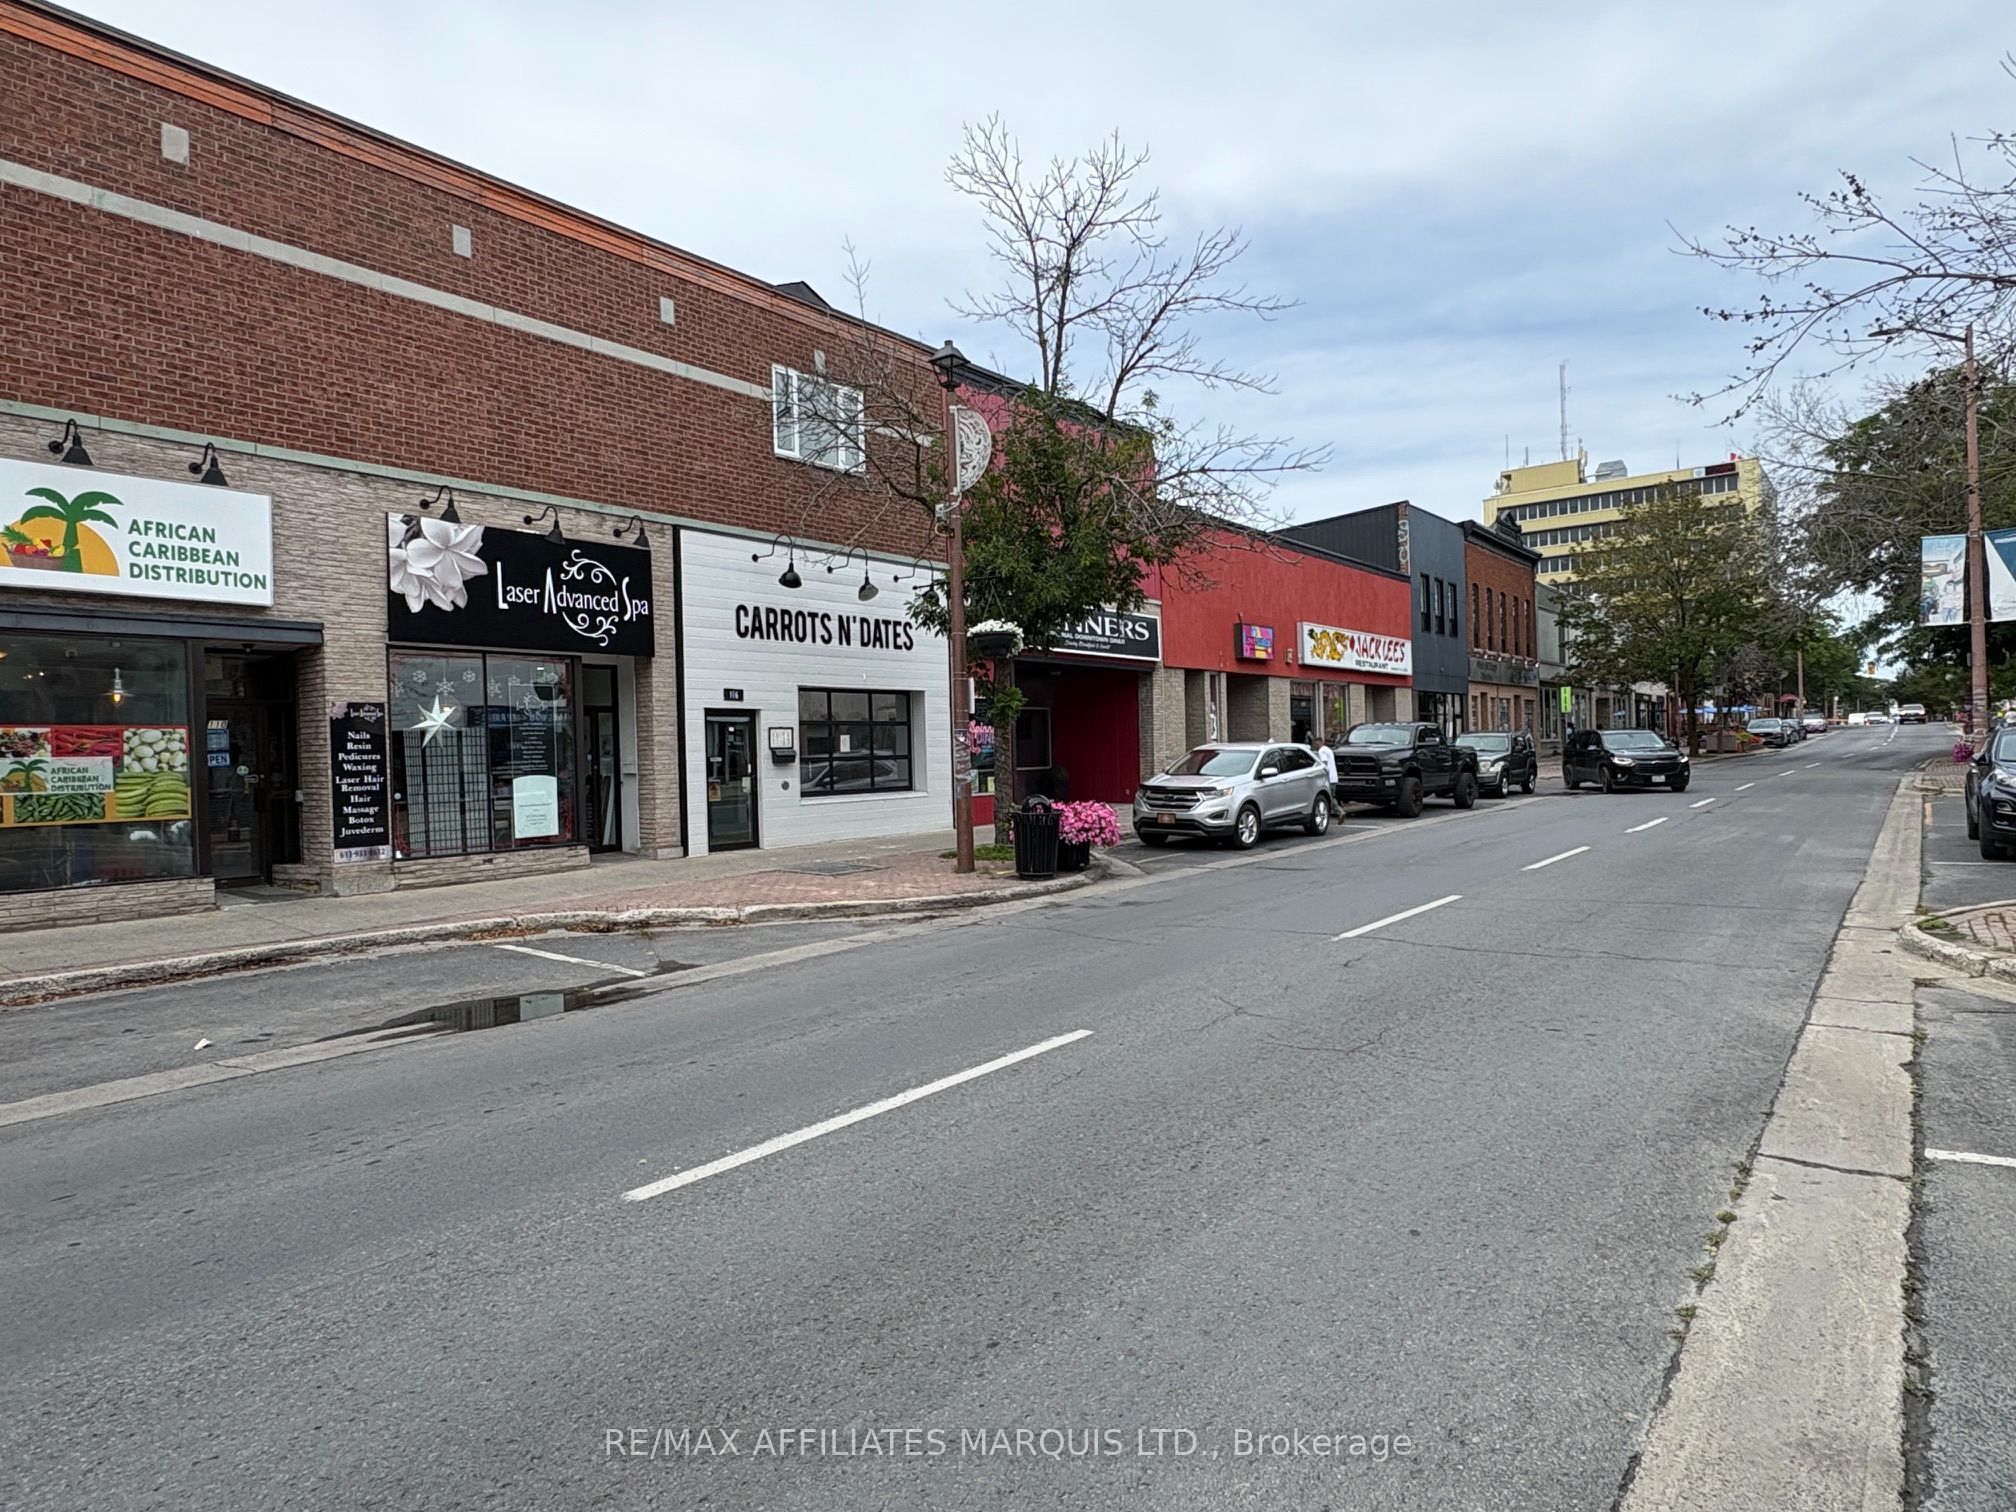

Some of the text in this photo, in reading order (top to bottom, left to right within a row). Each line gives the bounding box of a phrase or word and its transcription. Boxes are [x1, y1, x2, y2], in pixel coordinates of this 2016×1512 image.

[128, 519, 216, 544] AFRICAN
[128, 541, 240, 567] CARIBBEAN
[129, 562, 267, 590] DISTRIBUTION
[496, 561, 649, 622] Laser Advanced Spa
[735, 604, 833, 645] CARROTS
[1064, 615, 1150, 641] NNERS
[1355, 659, 1389, 670] RESTAURANT
[969, 720, 994, 738] Spinn
[347, 731, 371, 740] Nails
[346, 742, 372, 750] Resin
[208, 754, 228, 765] PEN
[338, 752, 382, 761] Pedicures
[50, 767, 89, 775] AFRICAN
[342, 762, 378, 774] Waxing
[50, 775, 100, 784] CARIBBEAN
[335, 775, 385, 784] Laser Hair
[50, 783, 112, 792] DISTRIBUTION
[340, 783, 380, 792] Removal
[350, 794, 372, 803] Hair
[342, 805, 380, 816] Massage
[348, 816, 375, 825] Botox
[339, 826, 384, 837] Juvederm
